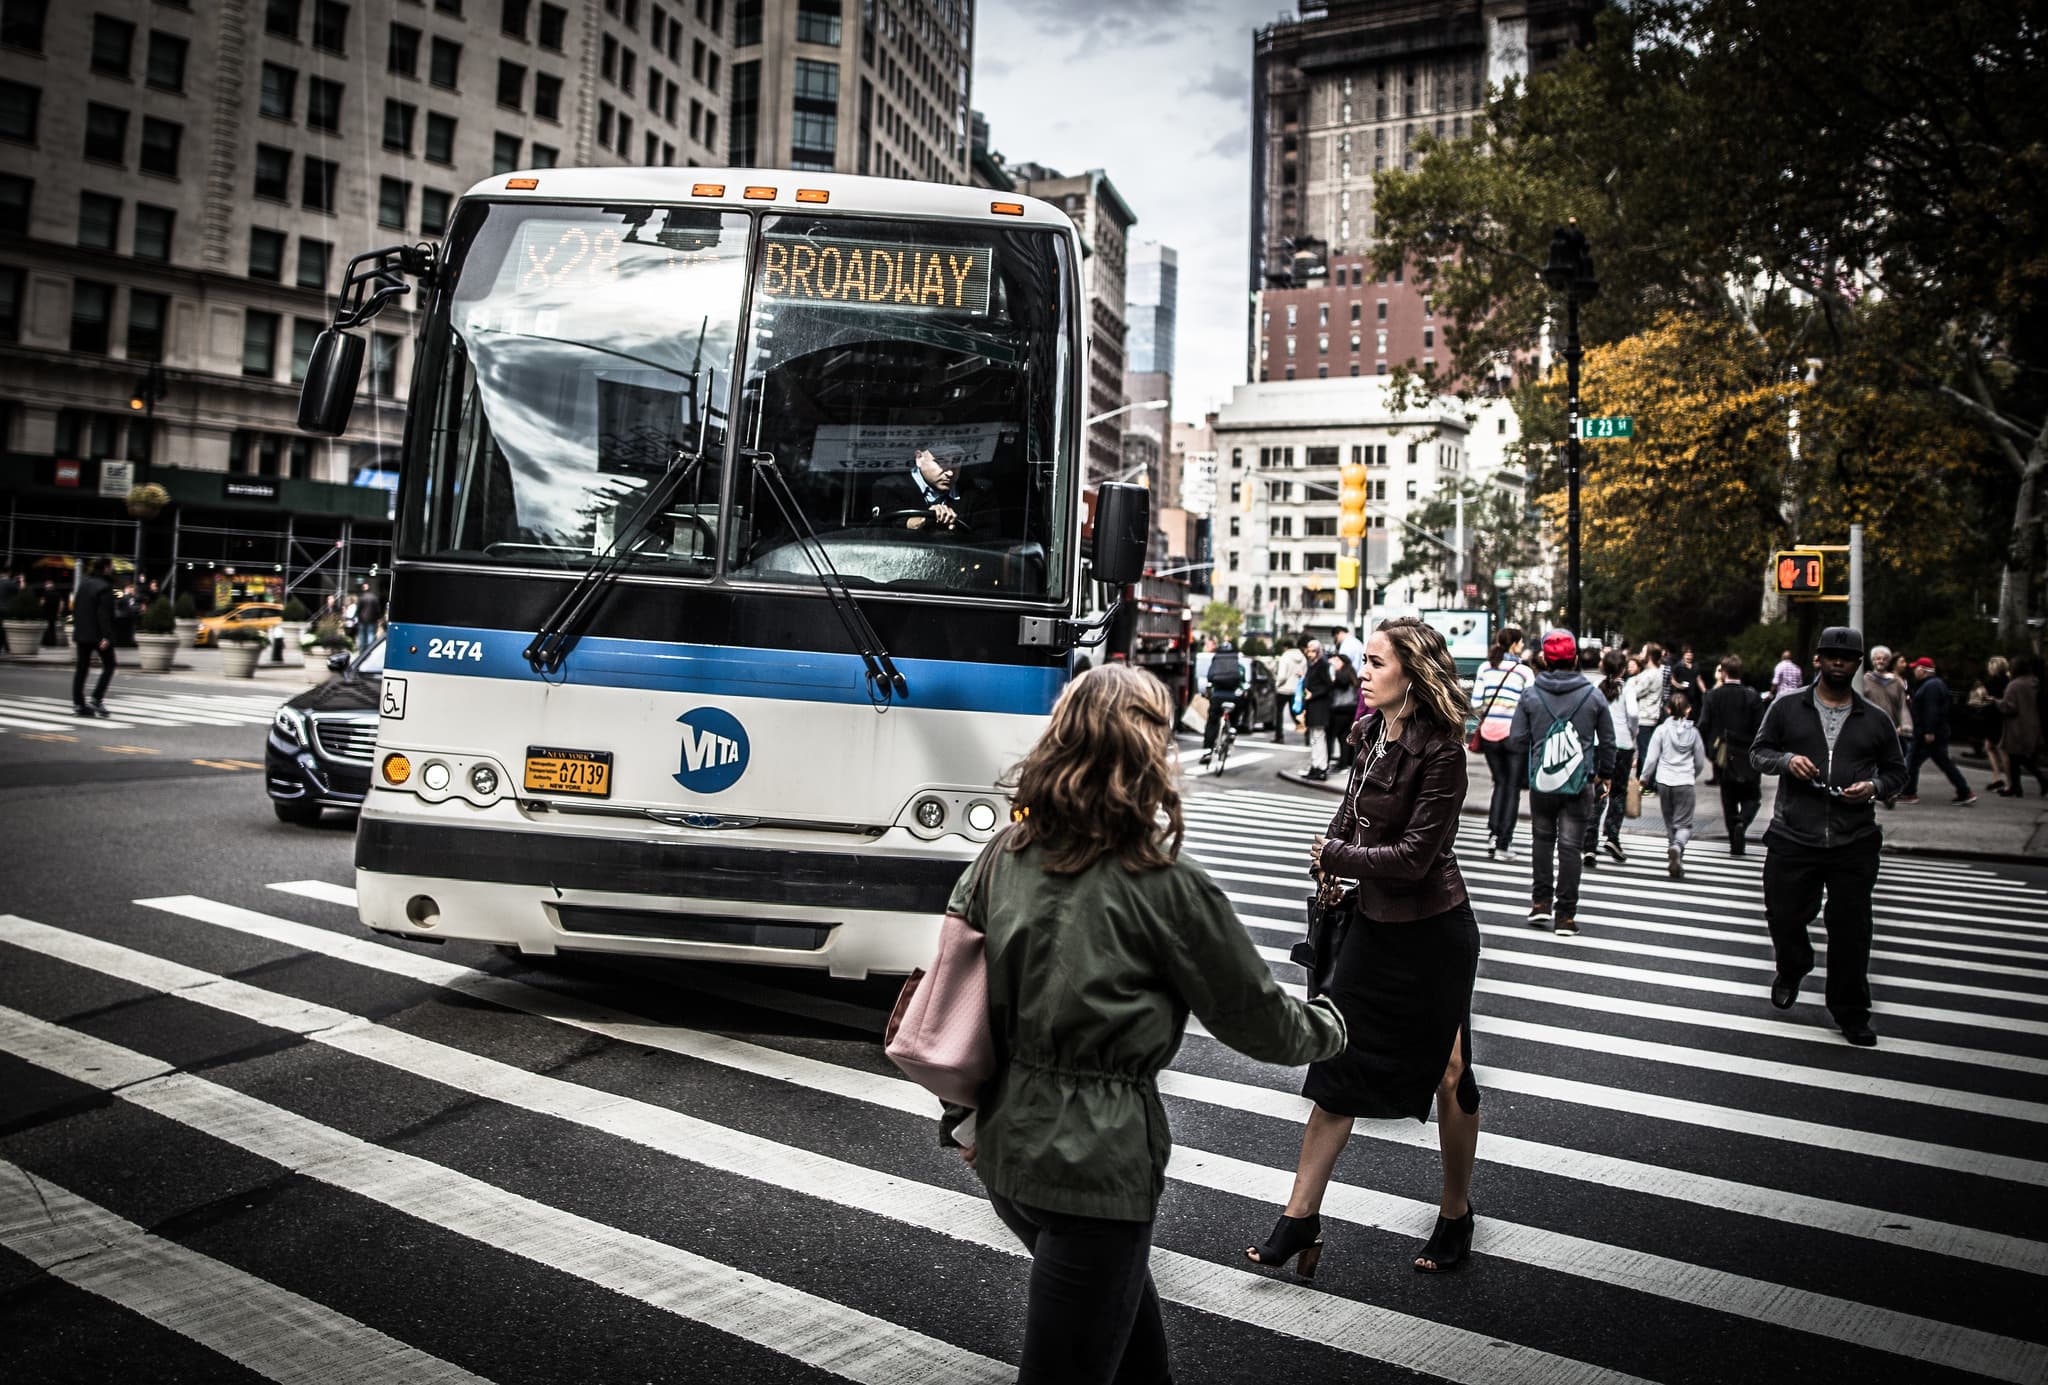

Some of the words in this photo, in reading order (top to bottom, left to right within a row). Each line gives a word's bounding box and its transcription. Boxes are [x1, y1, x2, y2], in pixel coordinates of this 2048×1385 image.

[763, 242, 973, 307] BROADWAY
[1586, 420, 1593, 436] E
[1598, 420, 1613, 436] 23
[1806, 561, 1820, 586] 0
[428, 638, 483, 662] 2474
[547, 751, 567, 760] NEW
[675, 721, 739, 775] MTA
